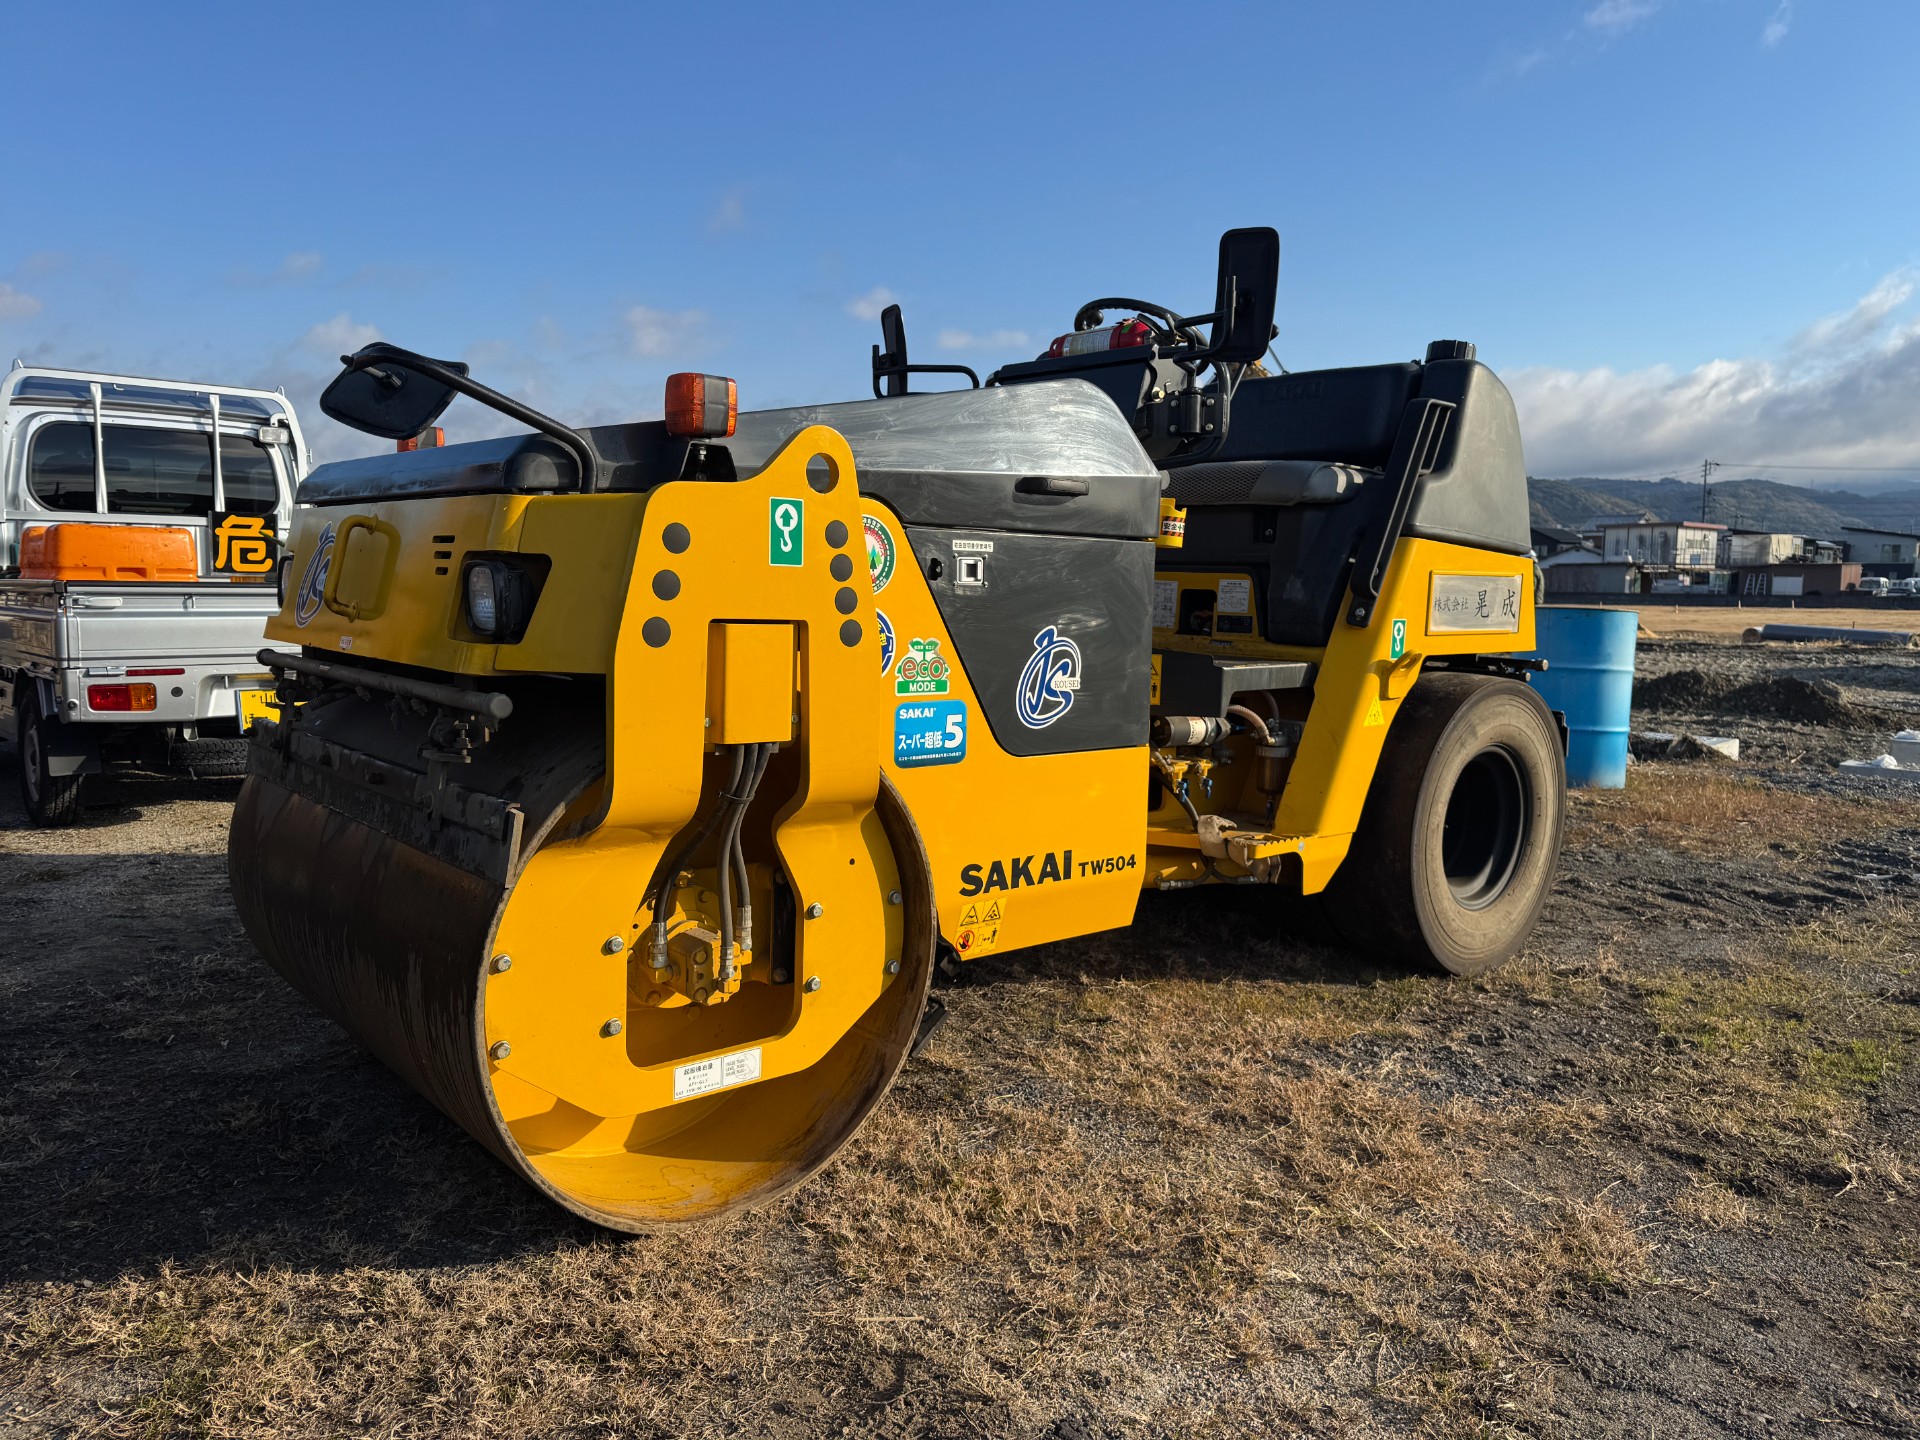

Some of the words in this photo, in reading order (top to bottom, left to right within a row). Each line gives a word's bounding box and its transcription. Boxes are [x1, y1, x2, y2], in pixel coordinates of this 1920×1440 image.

[215, 514, 273, 573] 危
[1434, 596, 1469, 612] 株式会社
[902, 659, 944, 680] eco
[909, 682, 936, 692] MODE
[1054, 680, 1079, 688] KOUSEI
[899, 708, 934, 719] SAKAI
[944, 714, 963, 749] 5
[959, 850, 1072, 897] SAKAI
[1078, 854, 1136, 877] TW504
